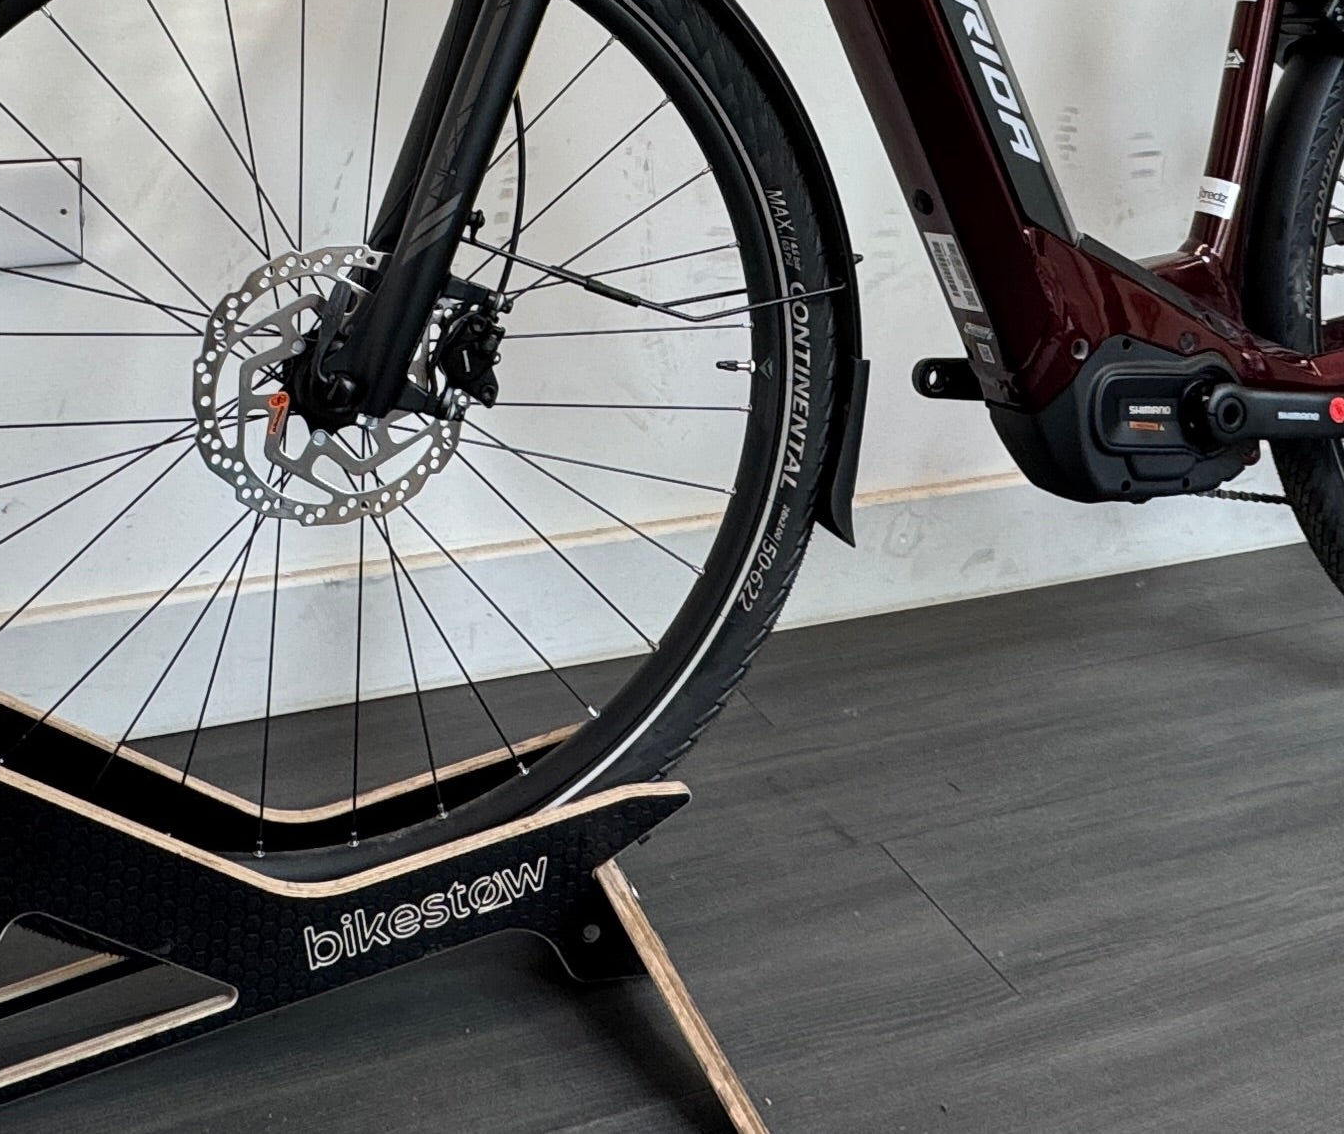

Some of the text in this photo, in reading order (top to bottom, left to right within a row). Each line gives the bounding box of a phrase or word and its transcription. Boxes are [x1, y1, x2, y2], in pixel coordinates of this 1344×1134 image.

[765, 189, 796, 234] MAX.
[779, 281, 812, 489] CONTINENTAL
[1128, 405, 1171, 415] SHIMANO
[738, 538, 778, 612] 50-622
